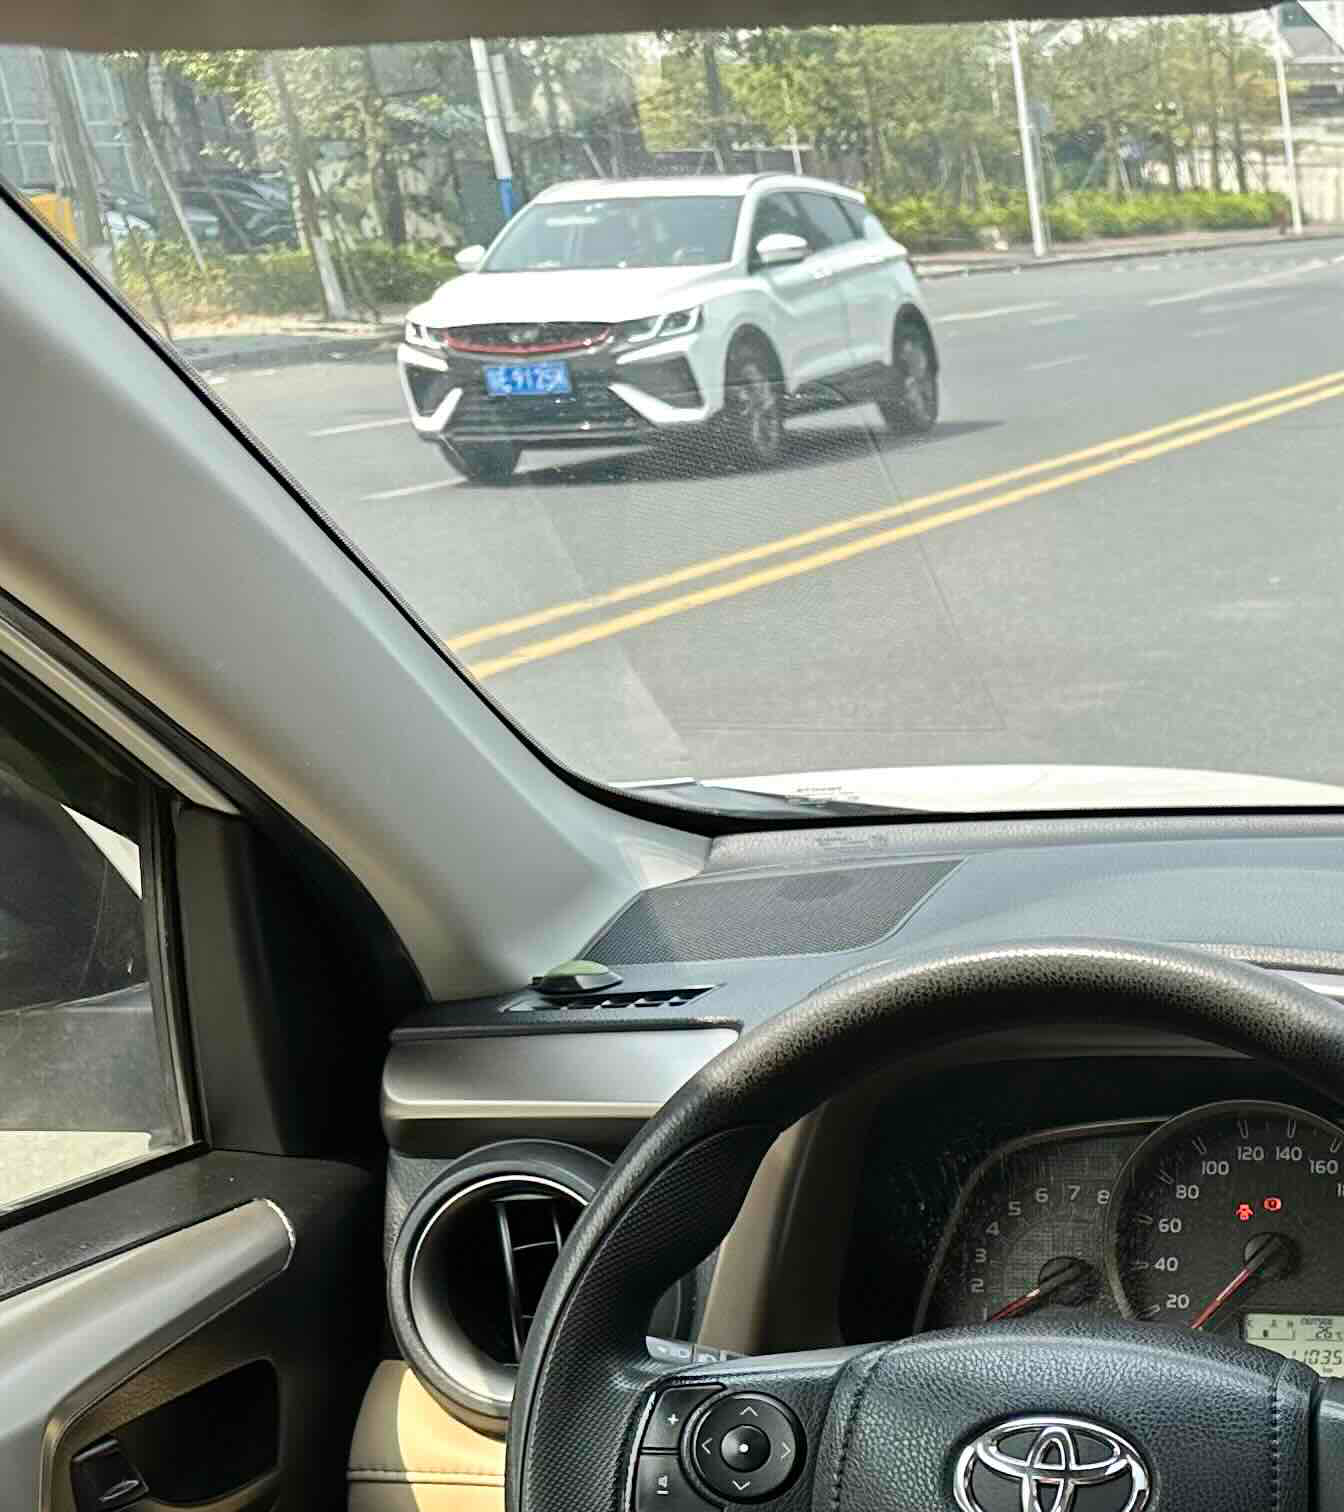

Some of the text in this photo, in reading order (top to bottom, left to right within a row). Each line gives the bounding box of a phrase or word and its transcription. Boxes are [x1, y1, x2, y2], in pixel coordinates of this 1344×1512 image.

[1238, 1146, 1264, 1160] 120
[1276, 1146, 1302, 1160] 140
[1201, 1160, 1229, 1175] 100
[1310, 1160, 1338, 1175] 160
[1035, 1187, 1049, 1203] 6
[1066, 1185, 1081, 1201] 7
[1096, 1189, 1110, 1205] 8
[1176, 1184, 1200, 1199] 80
[1008, 1202, 1021, 1217] 5
[984, 1221, 1000, 1237] 4
[1159, 1218, 1182, 1234] 60
[975, 1248, 988, 1263] 3
[1153, 1256, 1179, 1272] 40
[970, 1278, 984, 1294] 2
[1165, 1294, 1191, 1310] 20
